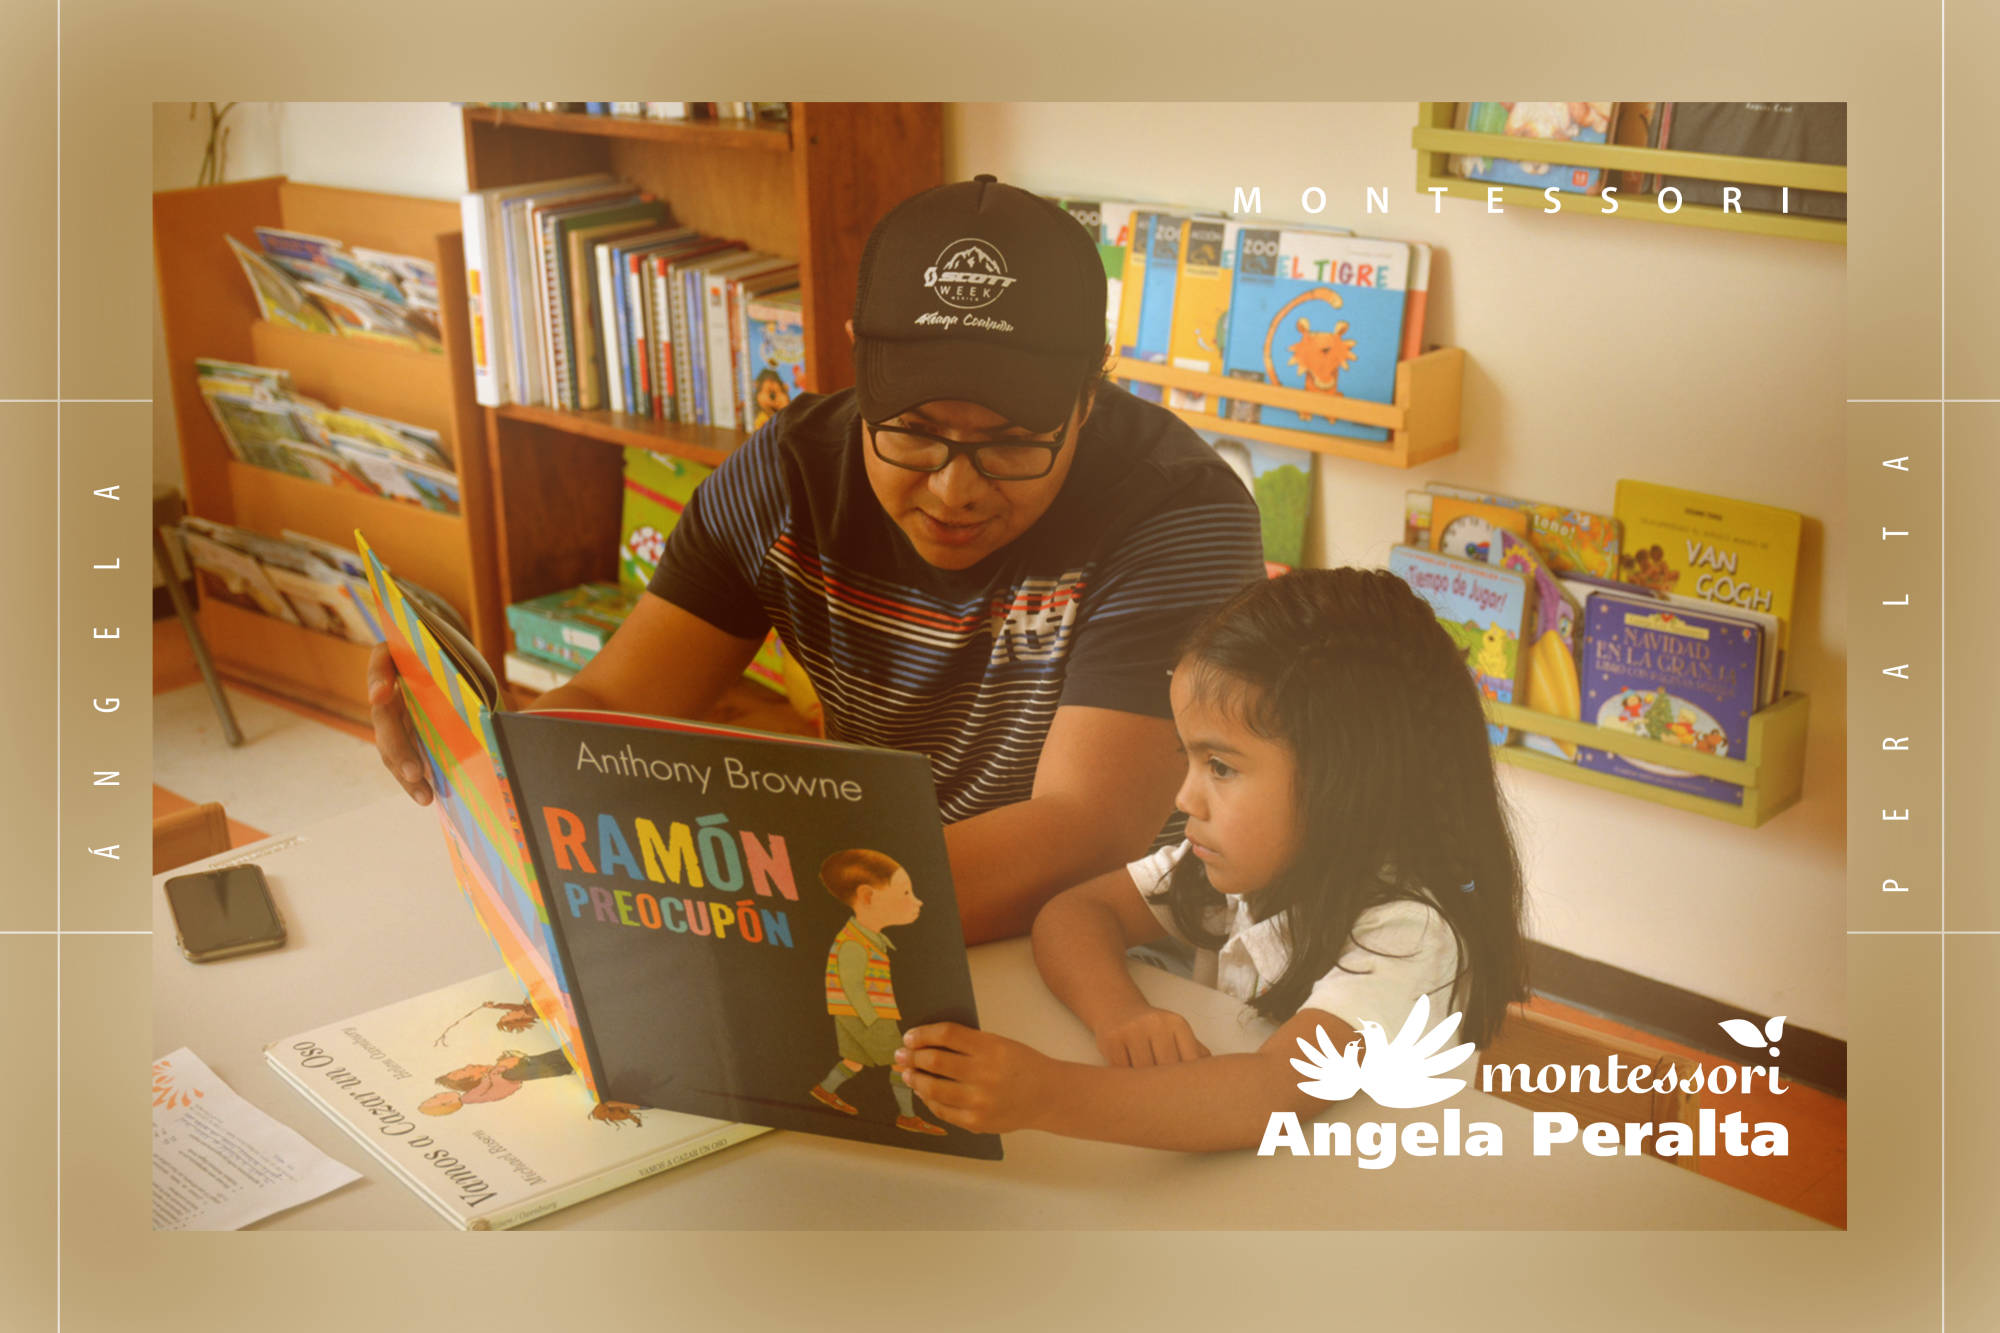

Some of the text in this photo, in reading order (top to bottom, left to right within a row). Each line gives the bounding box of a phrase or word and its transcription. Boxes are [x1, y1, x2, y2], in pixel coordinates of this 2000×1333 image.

[1069, 209, 1100, 227] OO
[1243, 237, 1278, 257] ZOO
[938, 270, 1017, 288] SCOTT
[1277, 255, 1390, 290] EL TIGRE
[940, 285, 991, 298] WEEK
[1685, 538, 1738, 575] VAN
[1452, 571, 1467, 597] de
[1696, 573, 1773, 611] GOGH
[1623, 626, 1711, 662] NAVIDAD
[1596, 639, 1622, 663] EN
[1626, 646, 1652, 670] LA
[1656, 652, 1737, 687] GRANJA
[576, 741, 863, 802] Anthony Browne
[542, 806, 799, 901] RAMÓN
[563, 882, 795, 948] PREOCUPÓN
[292, 1040, 498, 1208] Vamos a Cazar un Oso
[471, 1129, 548, 1187] Michael Rosen
